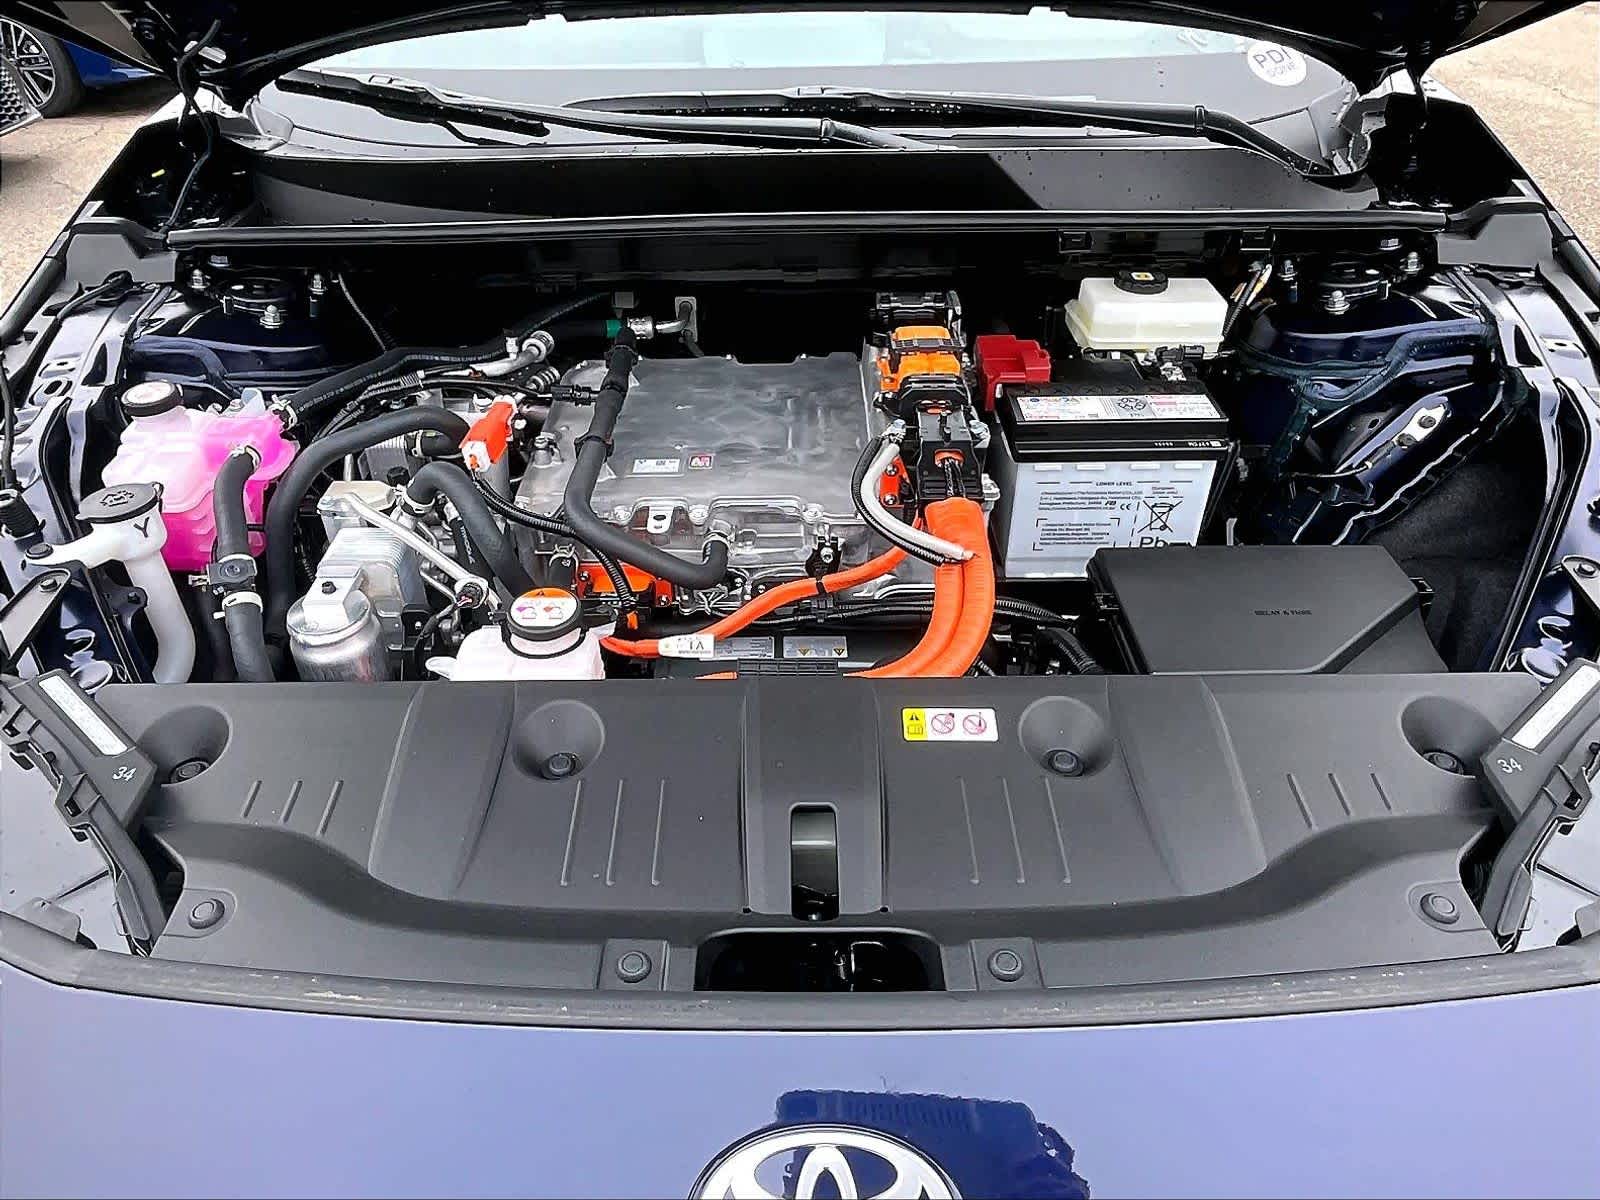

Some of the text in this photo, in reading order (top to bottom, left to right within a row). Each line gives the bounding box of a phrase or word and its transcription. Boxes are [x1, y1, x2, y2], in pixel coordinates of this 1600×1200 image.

[1252, 46, 1292, 69] PDI
[1140, 536, 1168, 548] Pb
[1497, 757, 1523, 774] 34
[112, 766, 137, 782] 34
